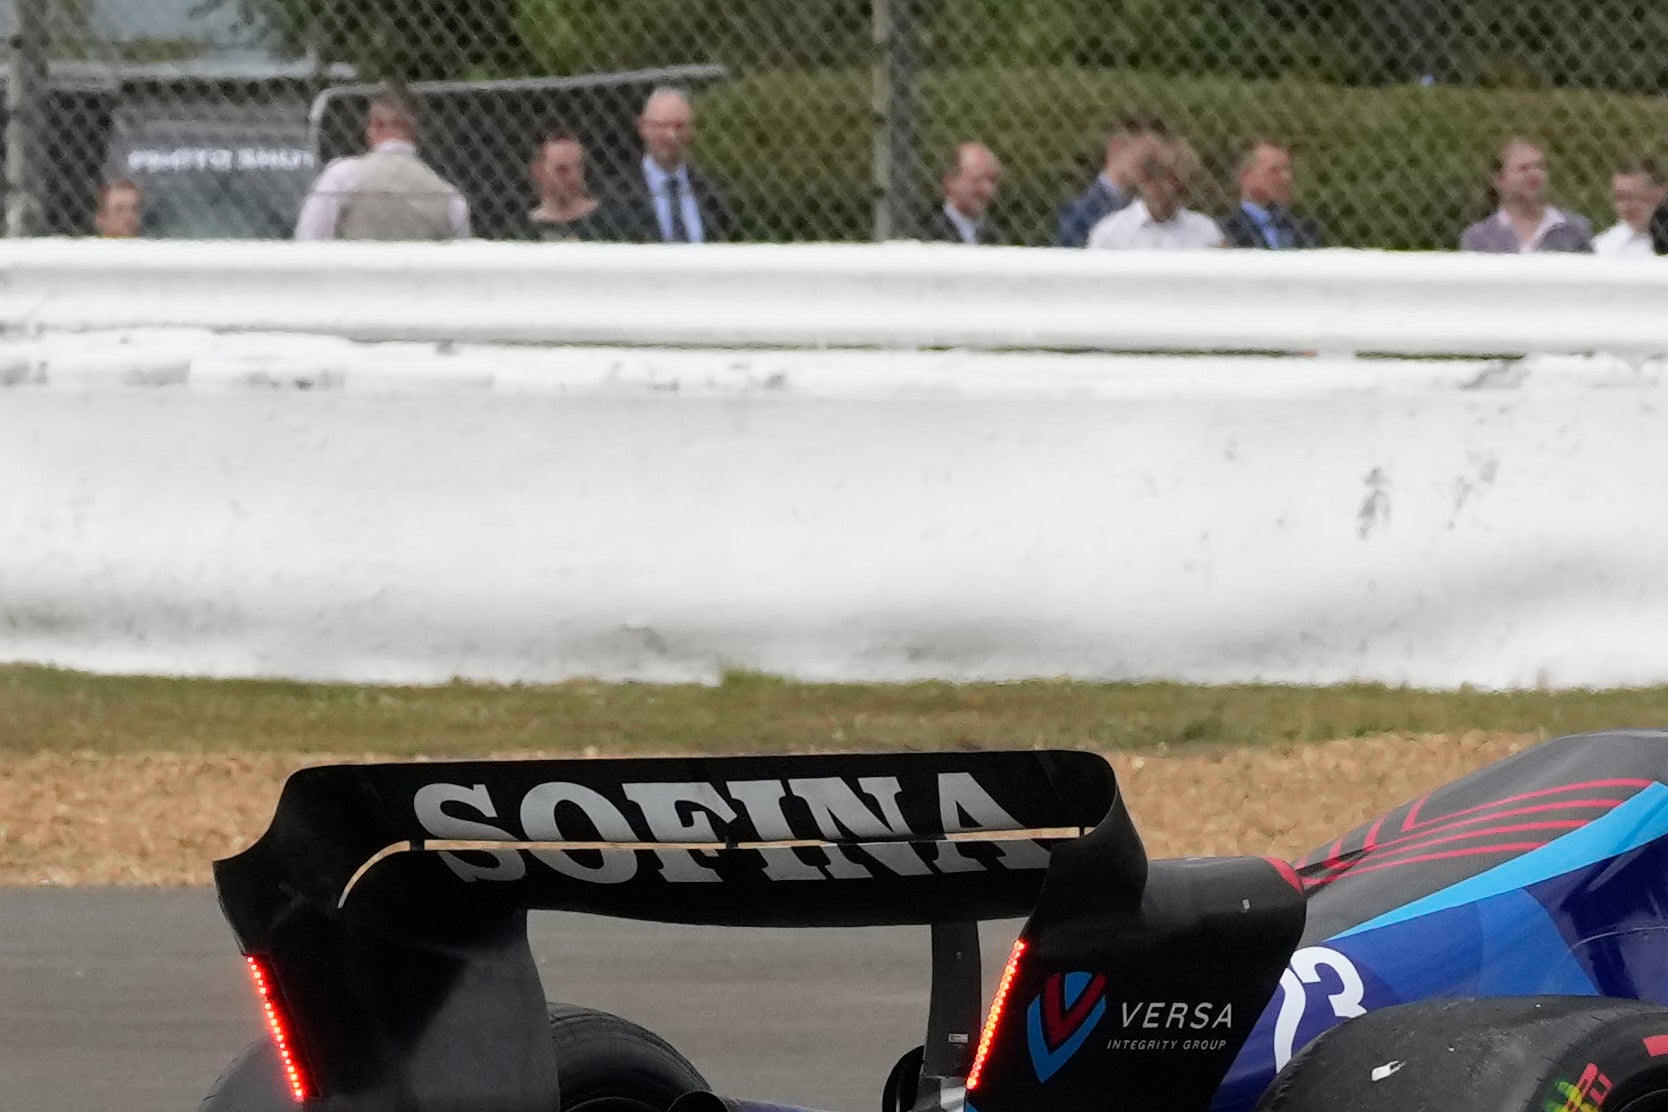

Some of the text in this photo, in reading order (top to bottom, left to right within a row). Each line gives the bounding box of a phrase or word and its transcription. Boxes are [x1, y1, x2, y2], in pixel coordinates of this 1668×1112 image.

[413, 771, 1053, 885] SOFINA
[1122, 1002, 1232, 1029] VERSA
[1107, 1039, 1227, 1050] INTEGRITY GROUP
